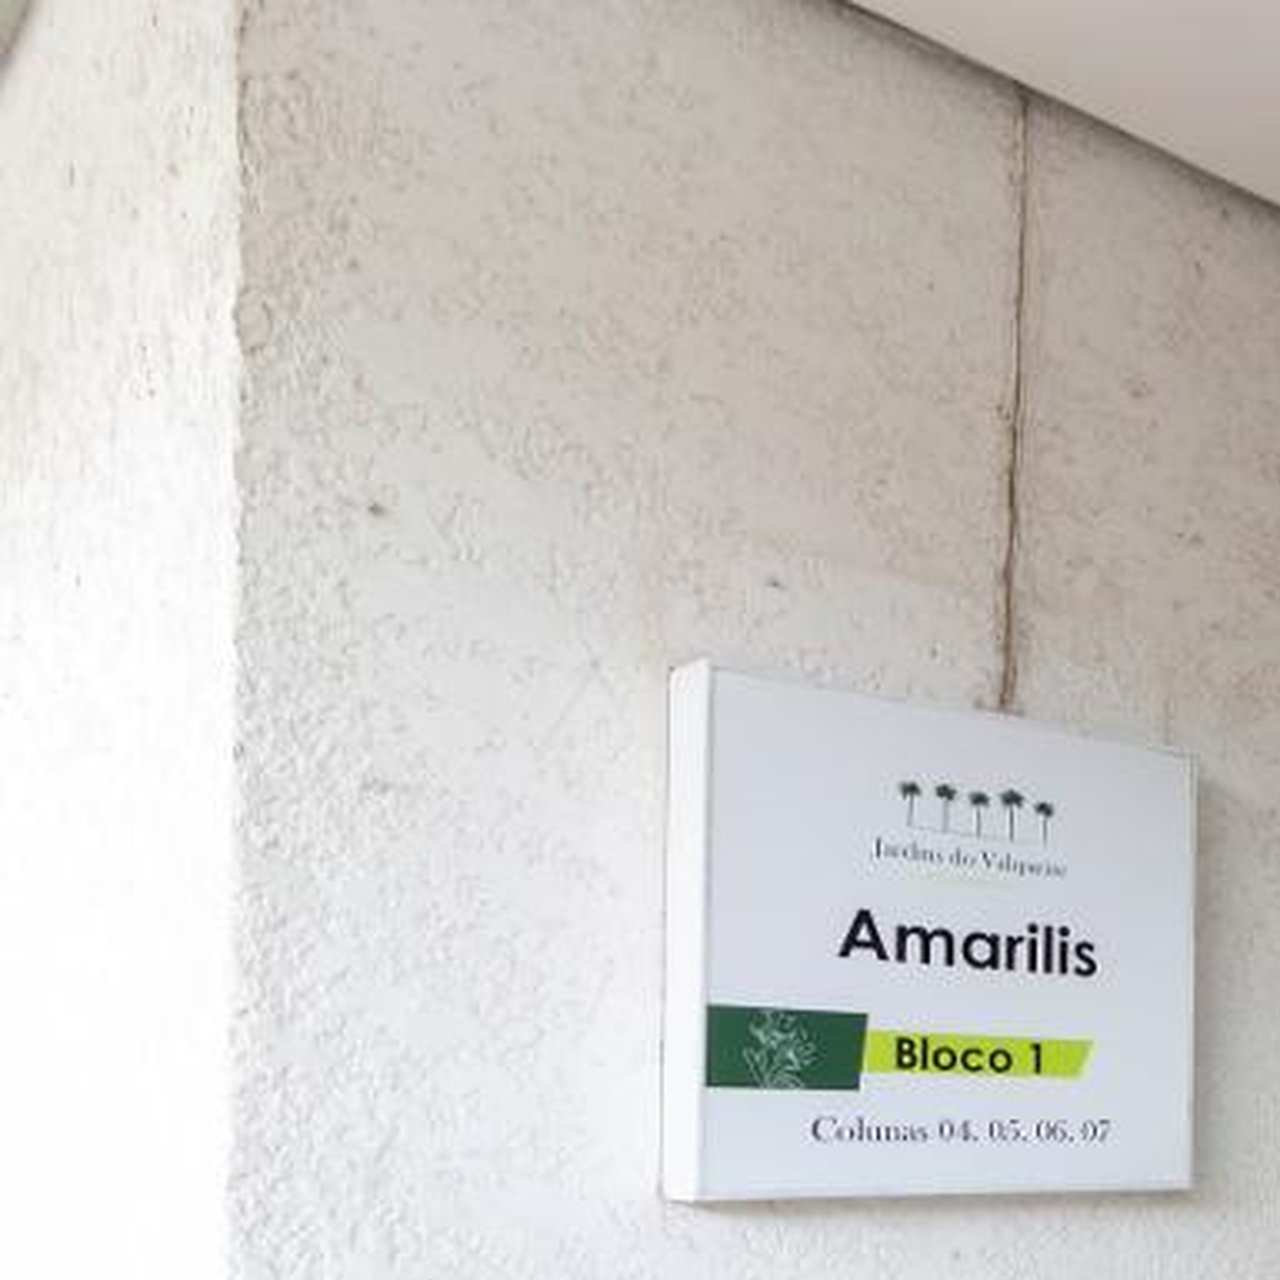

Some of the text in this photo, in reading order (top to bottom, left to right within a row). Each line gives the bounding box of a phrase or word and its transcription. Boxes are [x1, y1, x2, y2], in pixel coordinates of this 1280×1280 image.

[838, 908, 1098, 977] Amarilis
[895, 1036, 1042, 1074] Bloco 1
[811, 1115, 929, 1143] Colunas
[1080, 1118, 1111, 1142] 07
